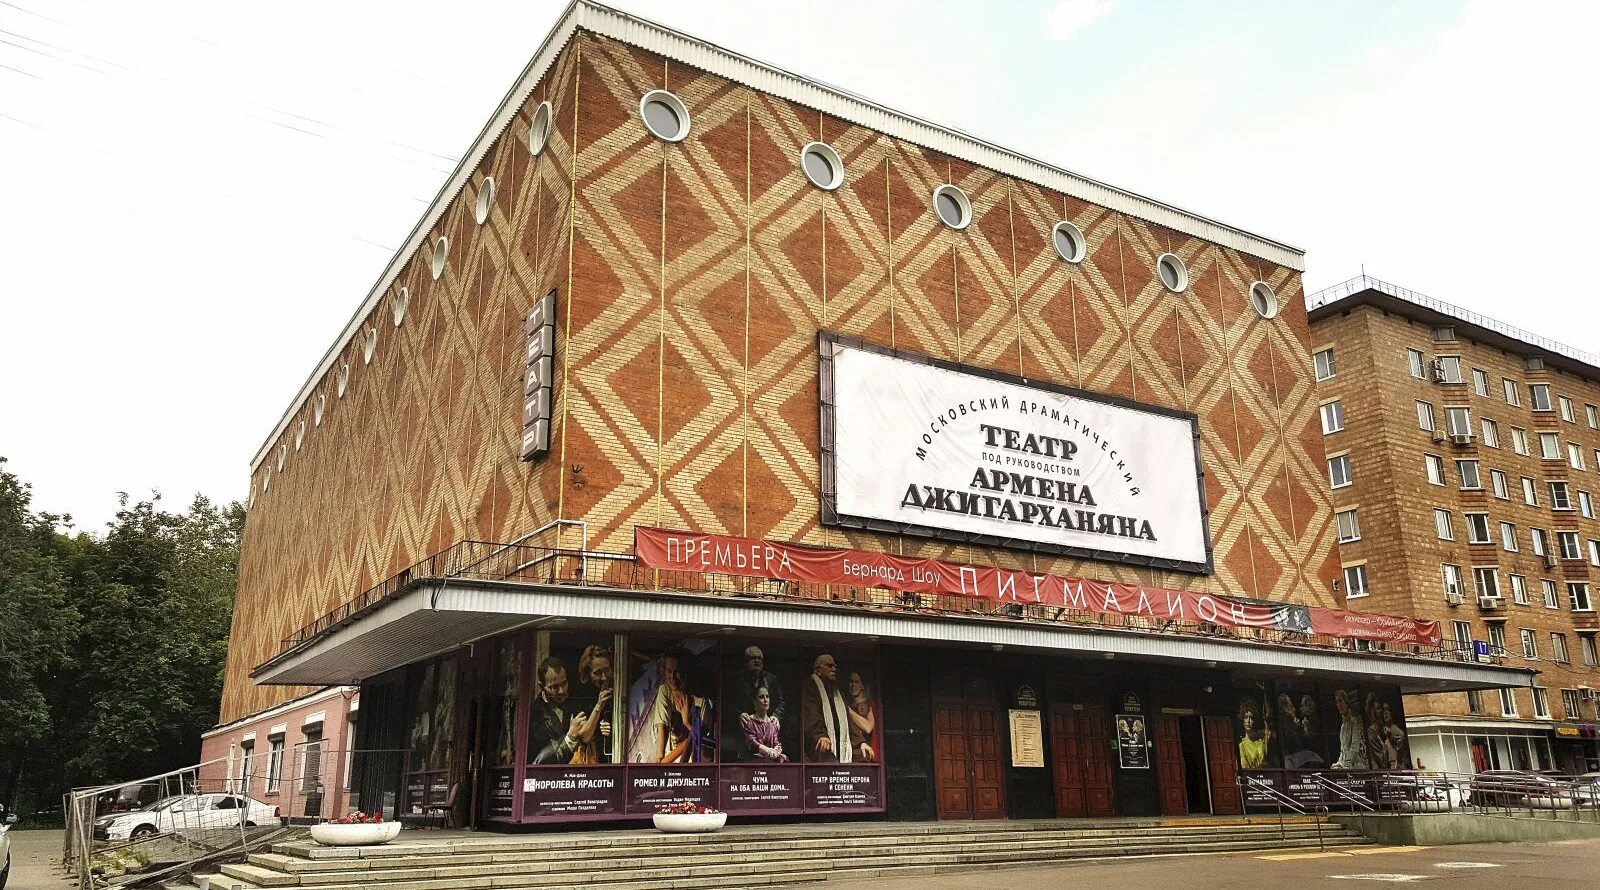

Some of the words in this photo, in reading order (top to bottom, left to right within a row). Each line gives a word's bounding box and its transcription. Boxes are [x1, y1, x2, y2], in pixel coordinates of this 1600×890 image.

[523, 306, 541, 447] ТЕАТР
[916, 395, 1010, 461] МОСКОВСКИЙ
[1019, 399, 1141, 497] ДРАМАТИЧЕСКИЙ
[980, 423, 1078, 461] ТЕАТР
[981, 452, 1002, 466] ПОД
[1005, 456, 1081, 477] РУКОВОДСТВОМ
[969, 466, 1098, 507] АРМЕНА
[901, 483, 1158, 543] ДЖИГАРХАНЯНА
[666, 537, 793, 573] ПРЕМЬЕРА
[843, 558, 905, 582] Бернард
[912, 567, 941, 588] Шоу
[959, 566, 1247, 625] ПИГМАЛИОН
[1478, 641, 1487, 654] 17
[535, 779, 576, 790] КОРОЛЕВА
[578, 779, 614, 789] КРАСОТЫ
[634, 778, 658, 788] РОМЕО
[660, 778, 665, 787] И
[667, 777, 710, 788] ДЖУЛЬЕТТА
[730, 784, 738, 792] НА
[752, 776, 768, 784] ЧУМА
[812, 776, 828, 784] ТЕАТР
